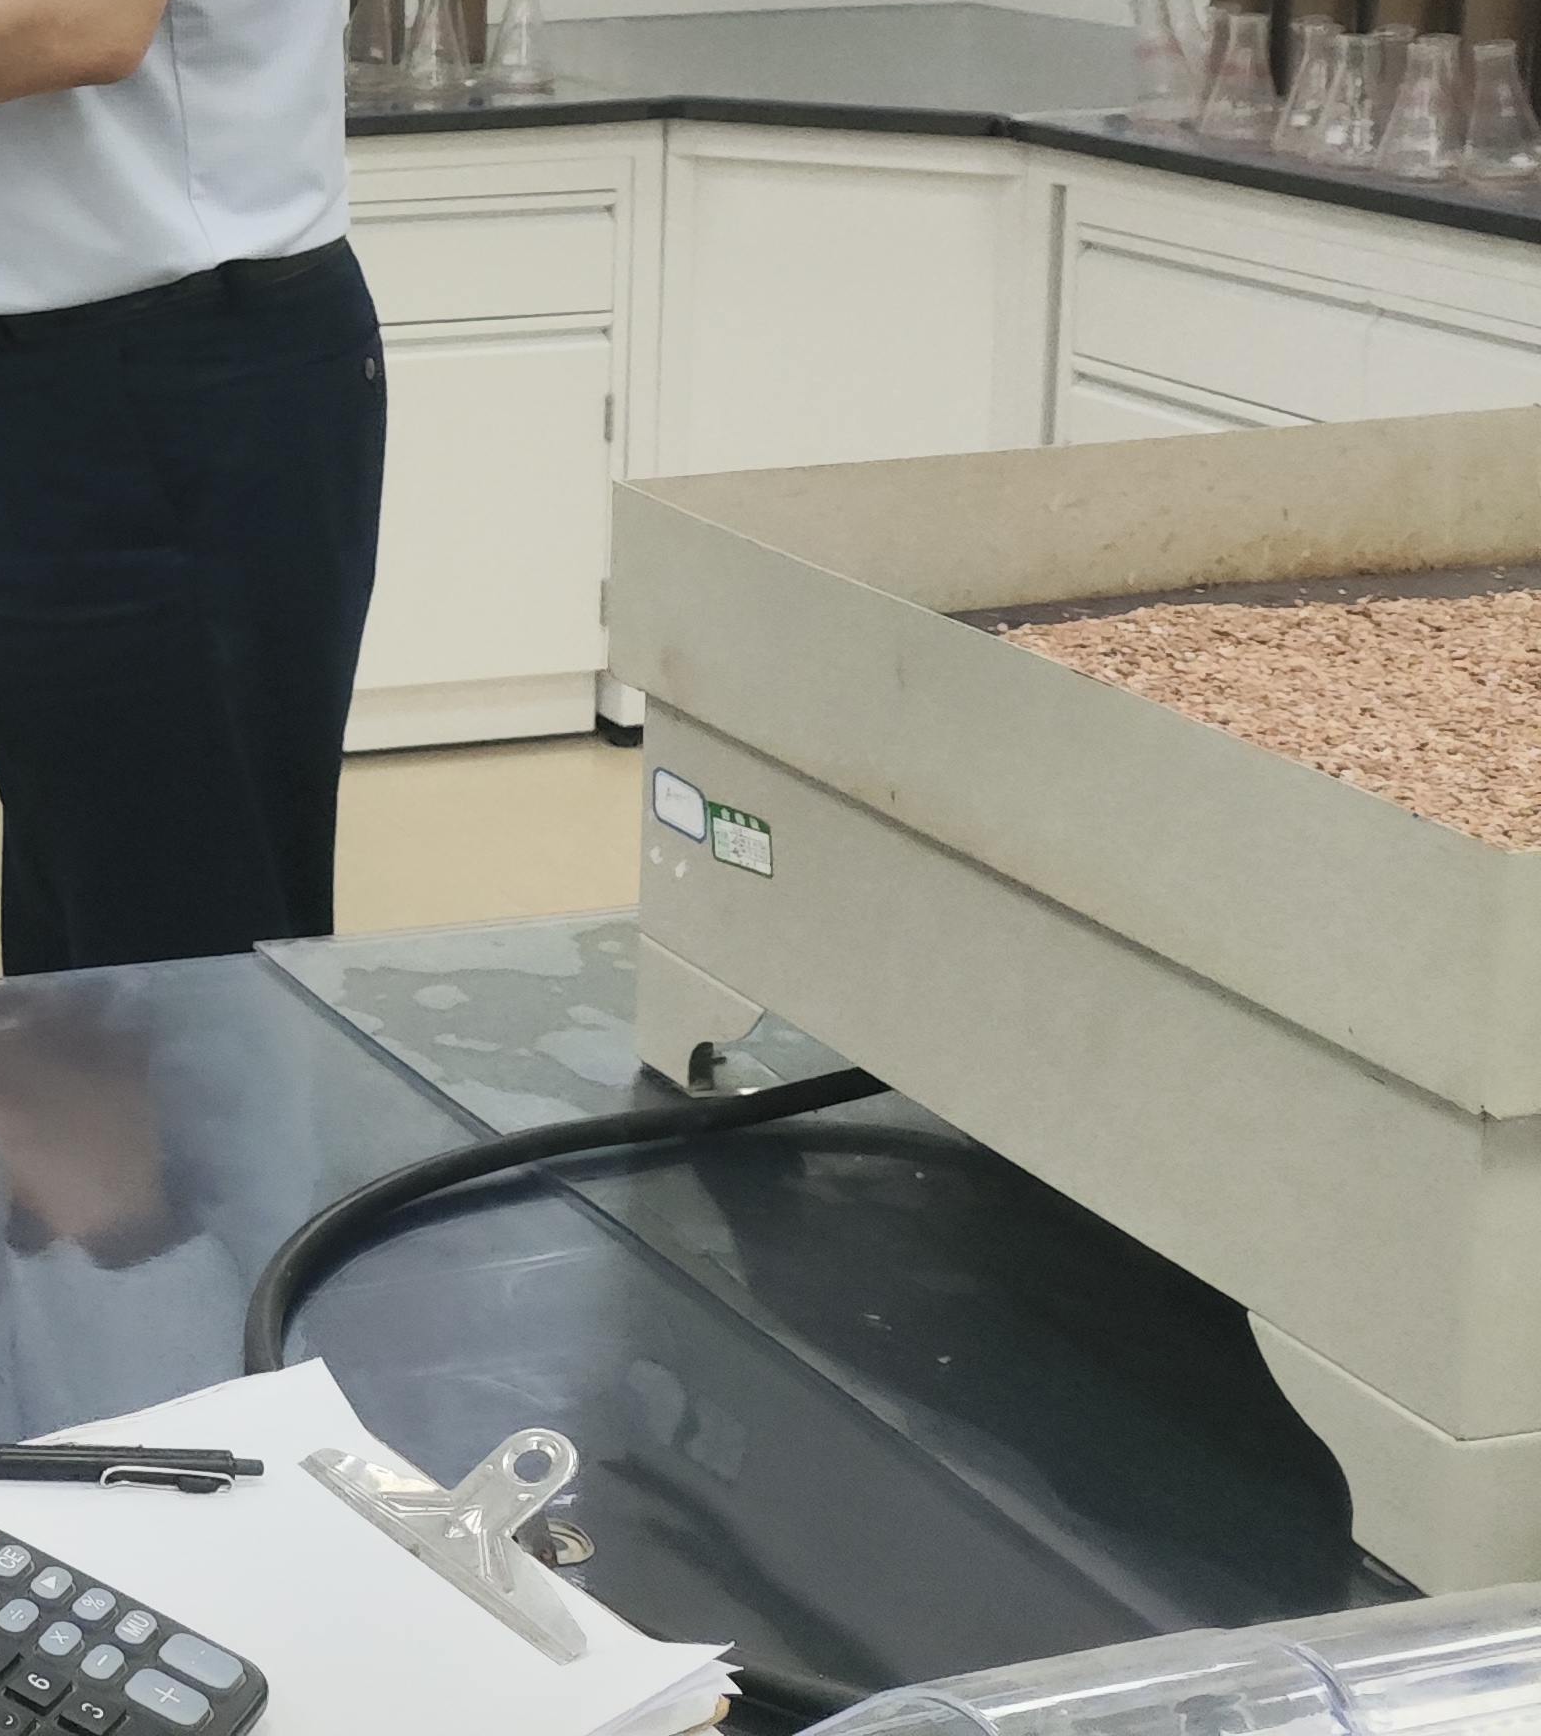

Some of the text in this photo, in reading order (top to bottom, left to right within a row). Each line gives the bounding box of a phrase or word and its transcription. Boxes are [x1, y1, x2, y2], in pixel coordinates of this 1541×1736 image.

[120, 1614, 150, 1638] MU
[27, 1673, 50, 1690] 6
[81, 1702, 104, 1719] 3
